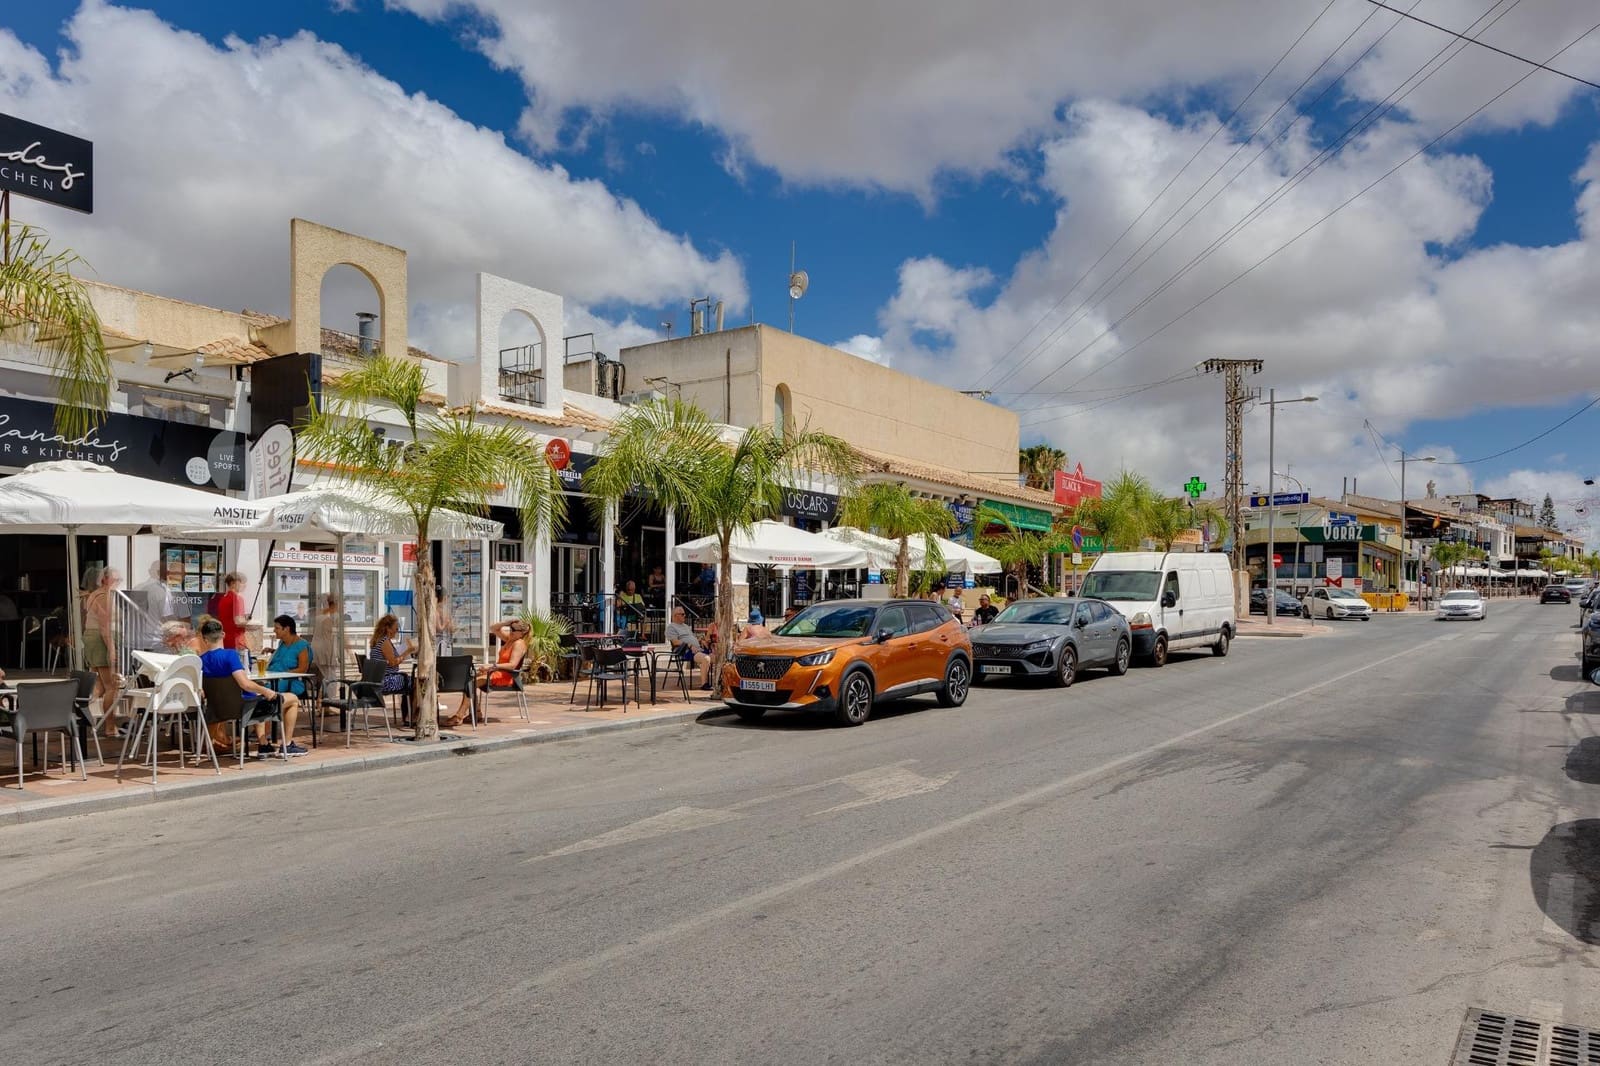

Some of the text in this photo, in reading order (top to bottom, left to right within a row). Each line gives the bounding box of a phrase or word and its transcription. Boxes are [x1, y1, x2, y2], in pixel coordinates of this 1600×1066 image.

[0, 141, 85, 190] des
[0, 167, 53, 191] CHEN
[21, 445, 29, 454] &
[39, 447, 104, 463] KITCHEN
[219, 453, 235, 462] LIVE
[213, 461, 241, 472] SPORTS
[787, 492, 829, 513] OSCARS
[213, 506, 260, 520] AMSTEL
[303, 553, 319, 561] FOR
[353, 556, 376, 564] 1000€
